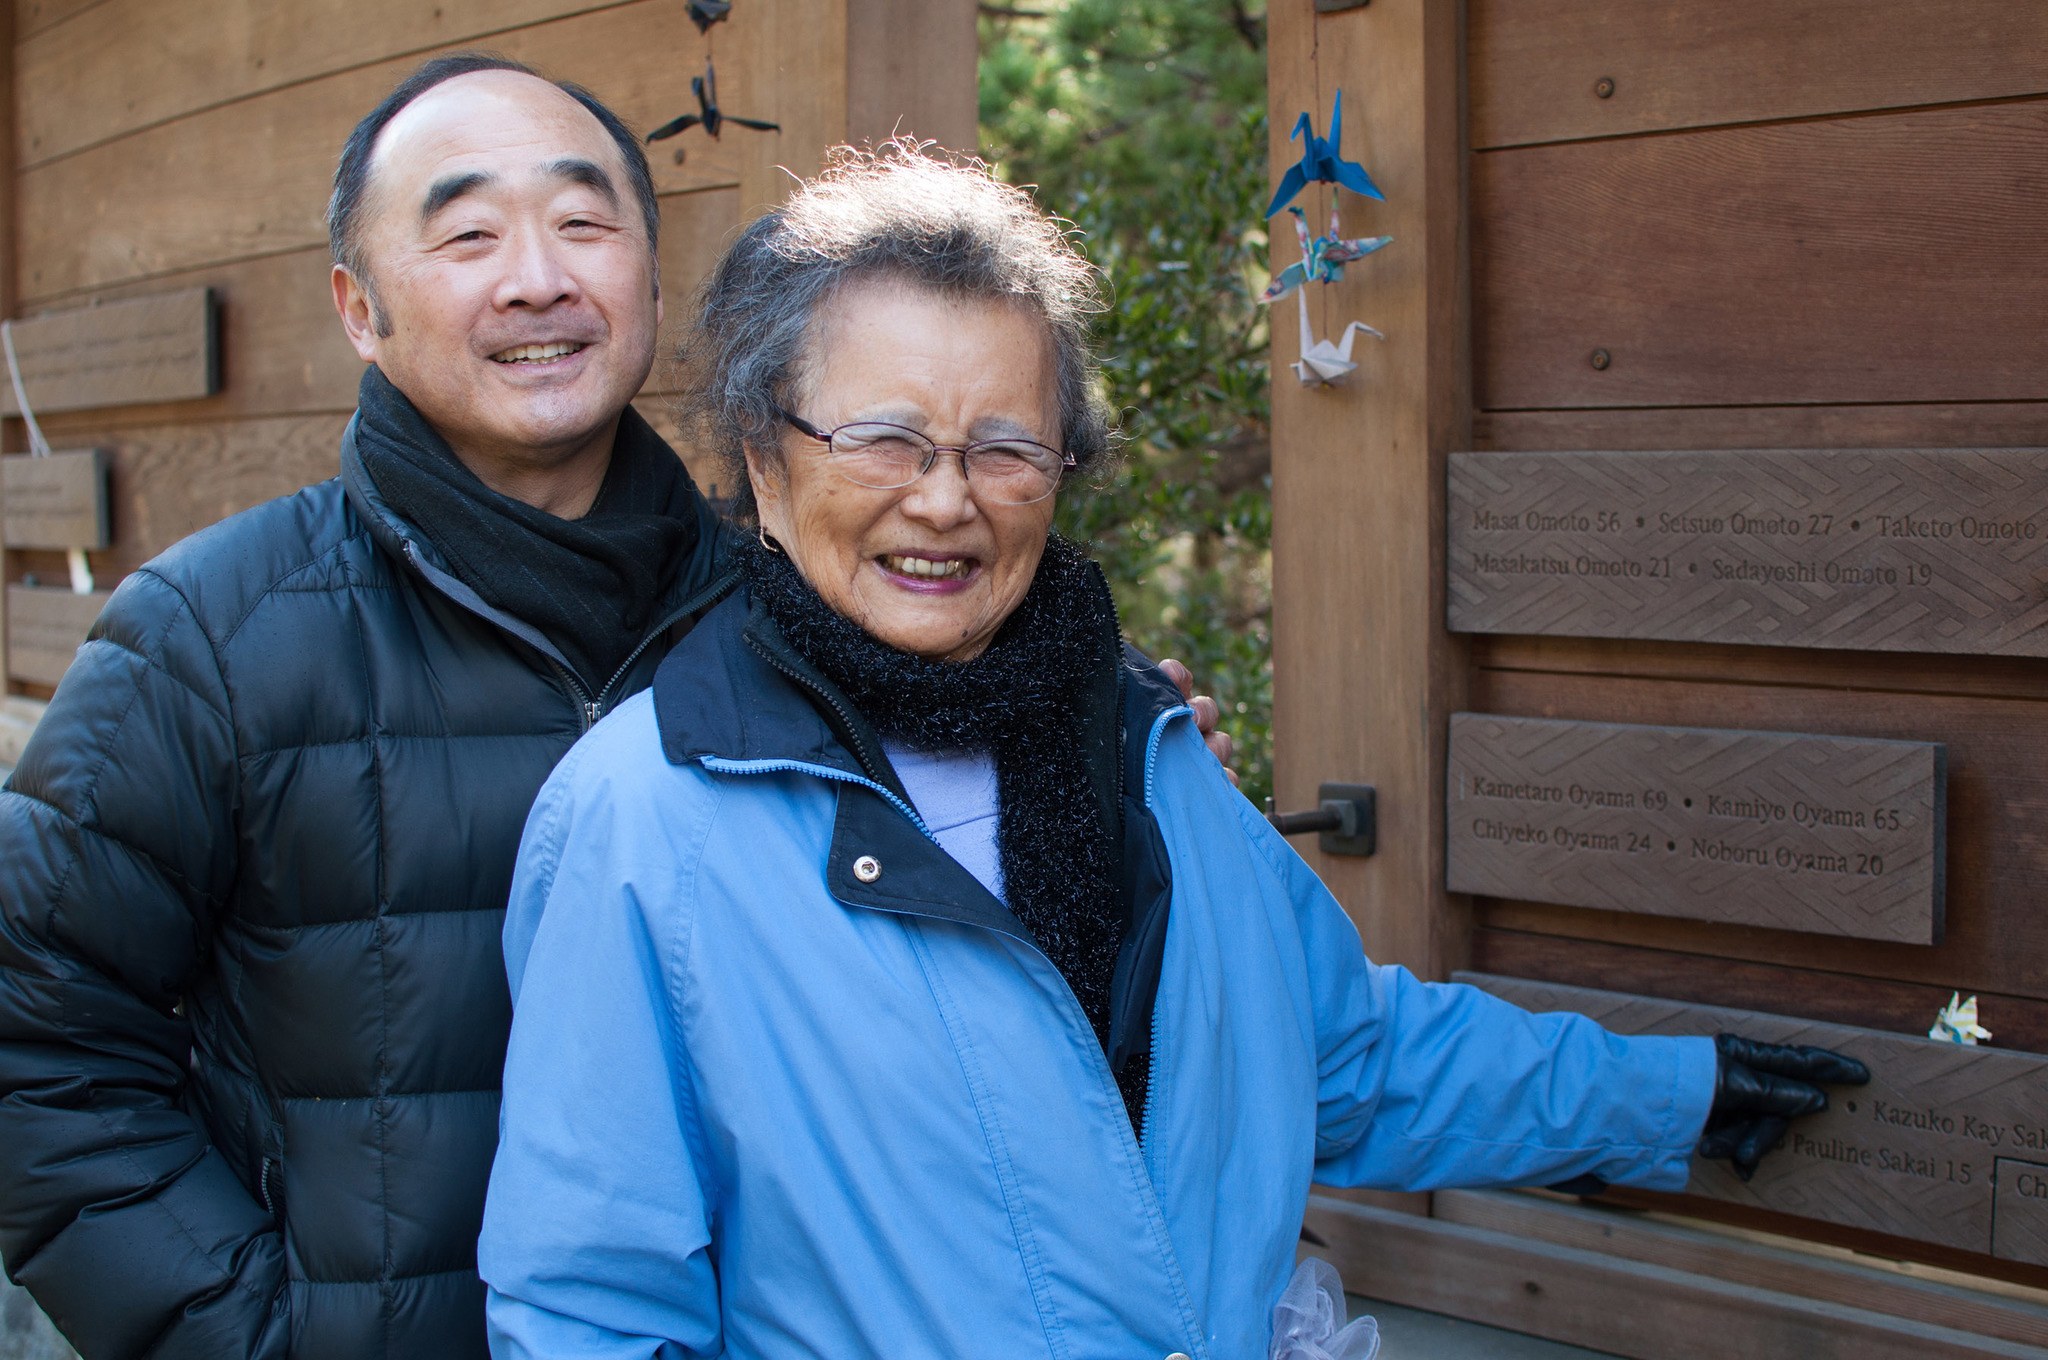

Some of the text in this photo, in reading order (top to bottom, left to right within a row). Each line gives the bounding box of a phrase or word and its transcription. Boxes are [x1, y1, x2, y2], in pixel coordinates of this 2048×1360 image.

[1474, 510, 1519, 530] Masa
[1526, 511, 1590, 531] Omoto
[1598, 512, 1621, 532] 56
[1659, 512, 1724, 534] Setsuo
[1731, 512, 1800, 536] Omoto
[1808, 515, 1833, 535] 27
[1876, 515, 1952, 538] Taketo
[1961, 516, 2037, 539] Omoto
[1474, 553, 1932, 585] Masakatsu Omoto 21 Sadayoshi Omoto 19
[1473, 777, 1900, 830] Kametaro Oyama 69 Kamiyo Oyama 65
[1473, 819, 1884, 876] Chiyeko Oyama 24 Noboru Oyama 20
[1873, 1100, 1955, 1134] Kazuko
[1962, 1115, 2005, 1146] Kay
[1793, 1133, 1971, 1185] Pauline Sakai 15
[2017, 1173, 2048, 1198] Ch
